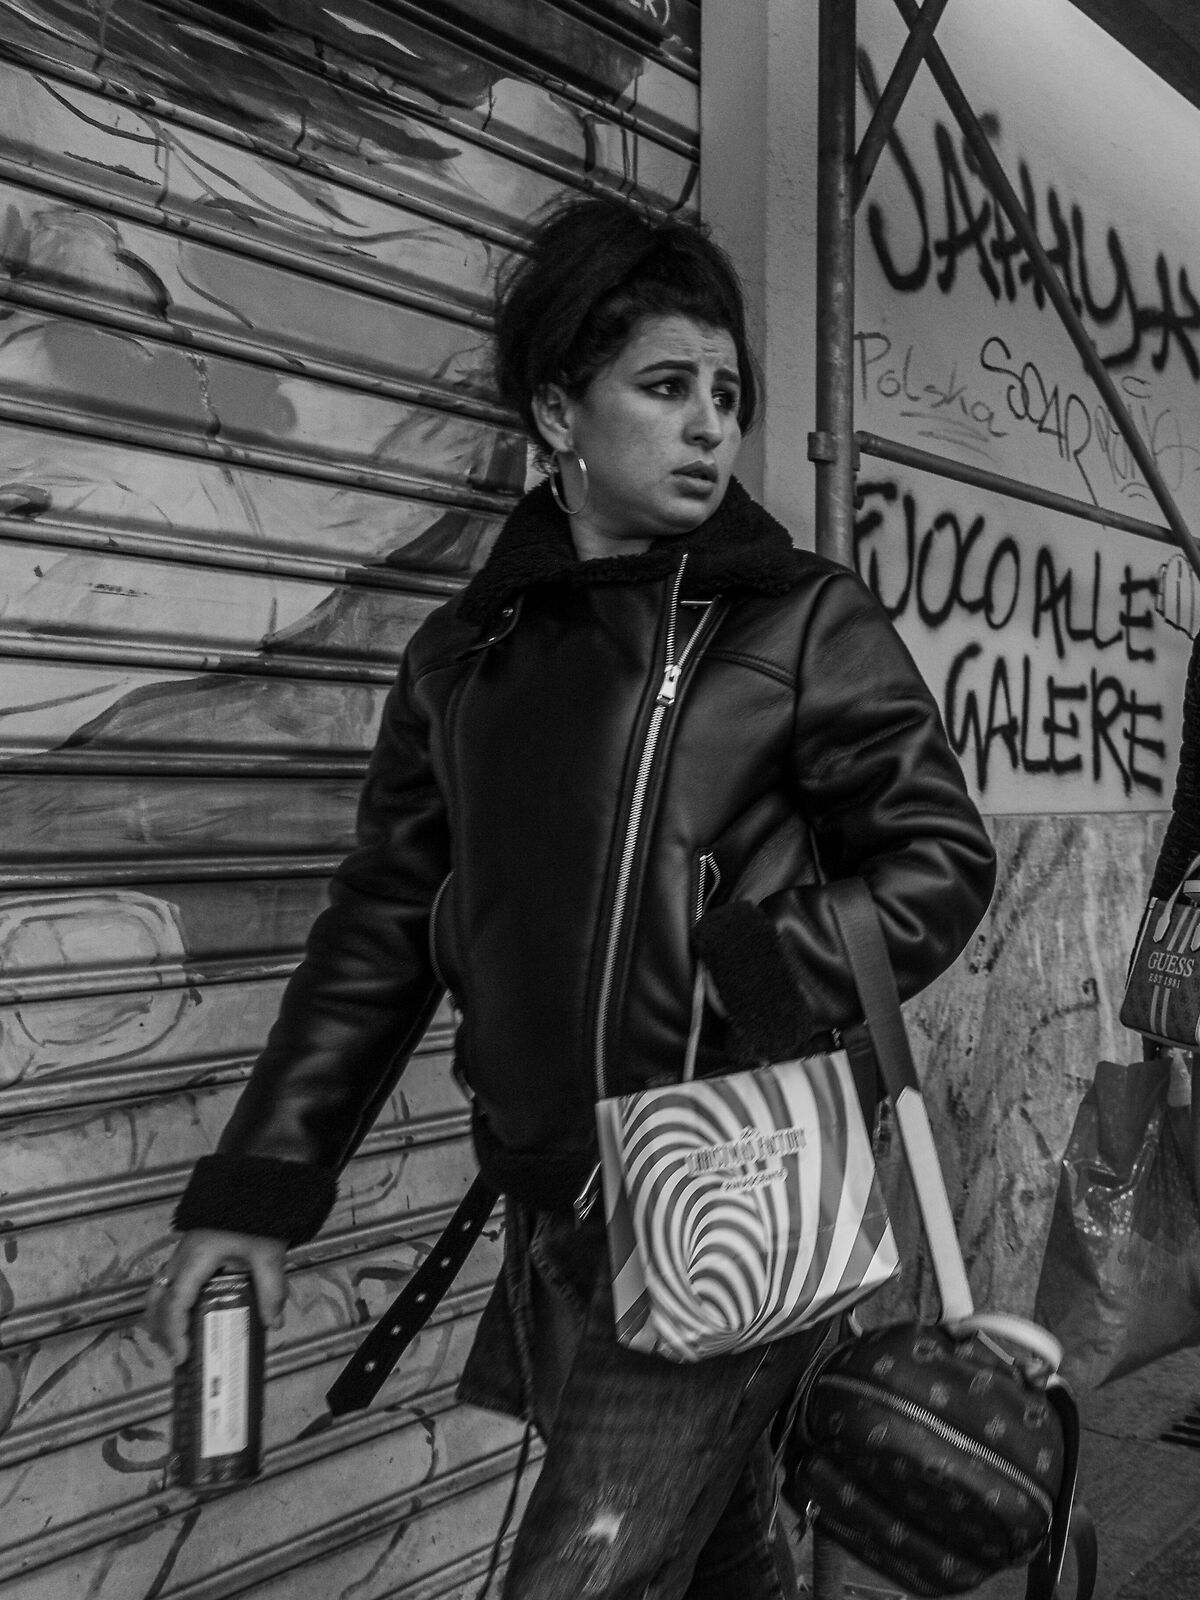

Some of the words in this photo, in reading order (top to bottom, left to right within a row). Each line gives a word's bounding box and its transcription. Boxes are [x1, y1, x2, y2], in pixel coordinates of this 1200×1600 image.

[1032, 546, 1158, 662] ALLE
[945, 641, 1167, 797] GALERE
[1148, 951, 1195, 977] GUESS
